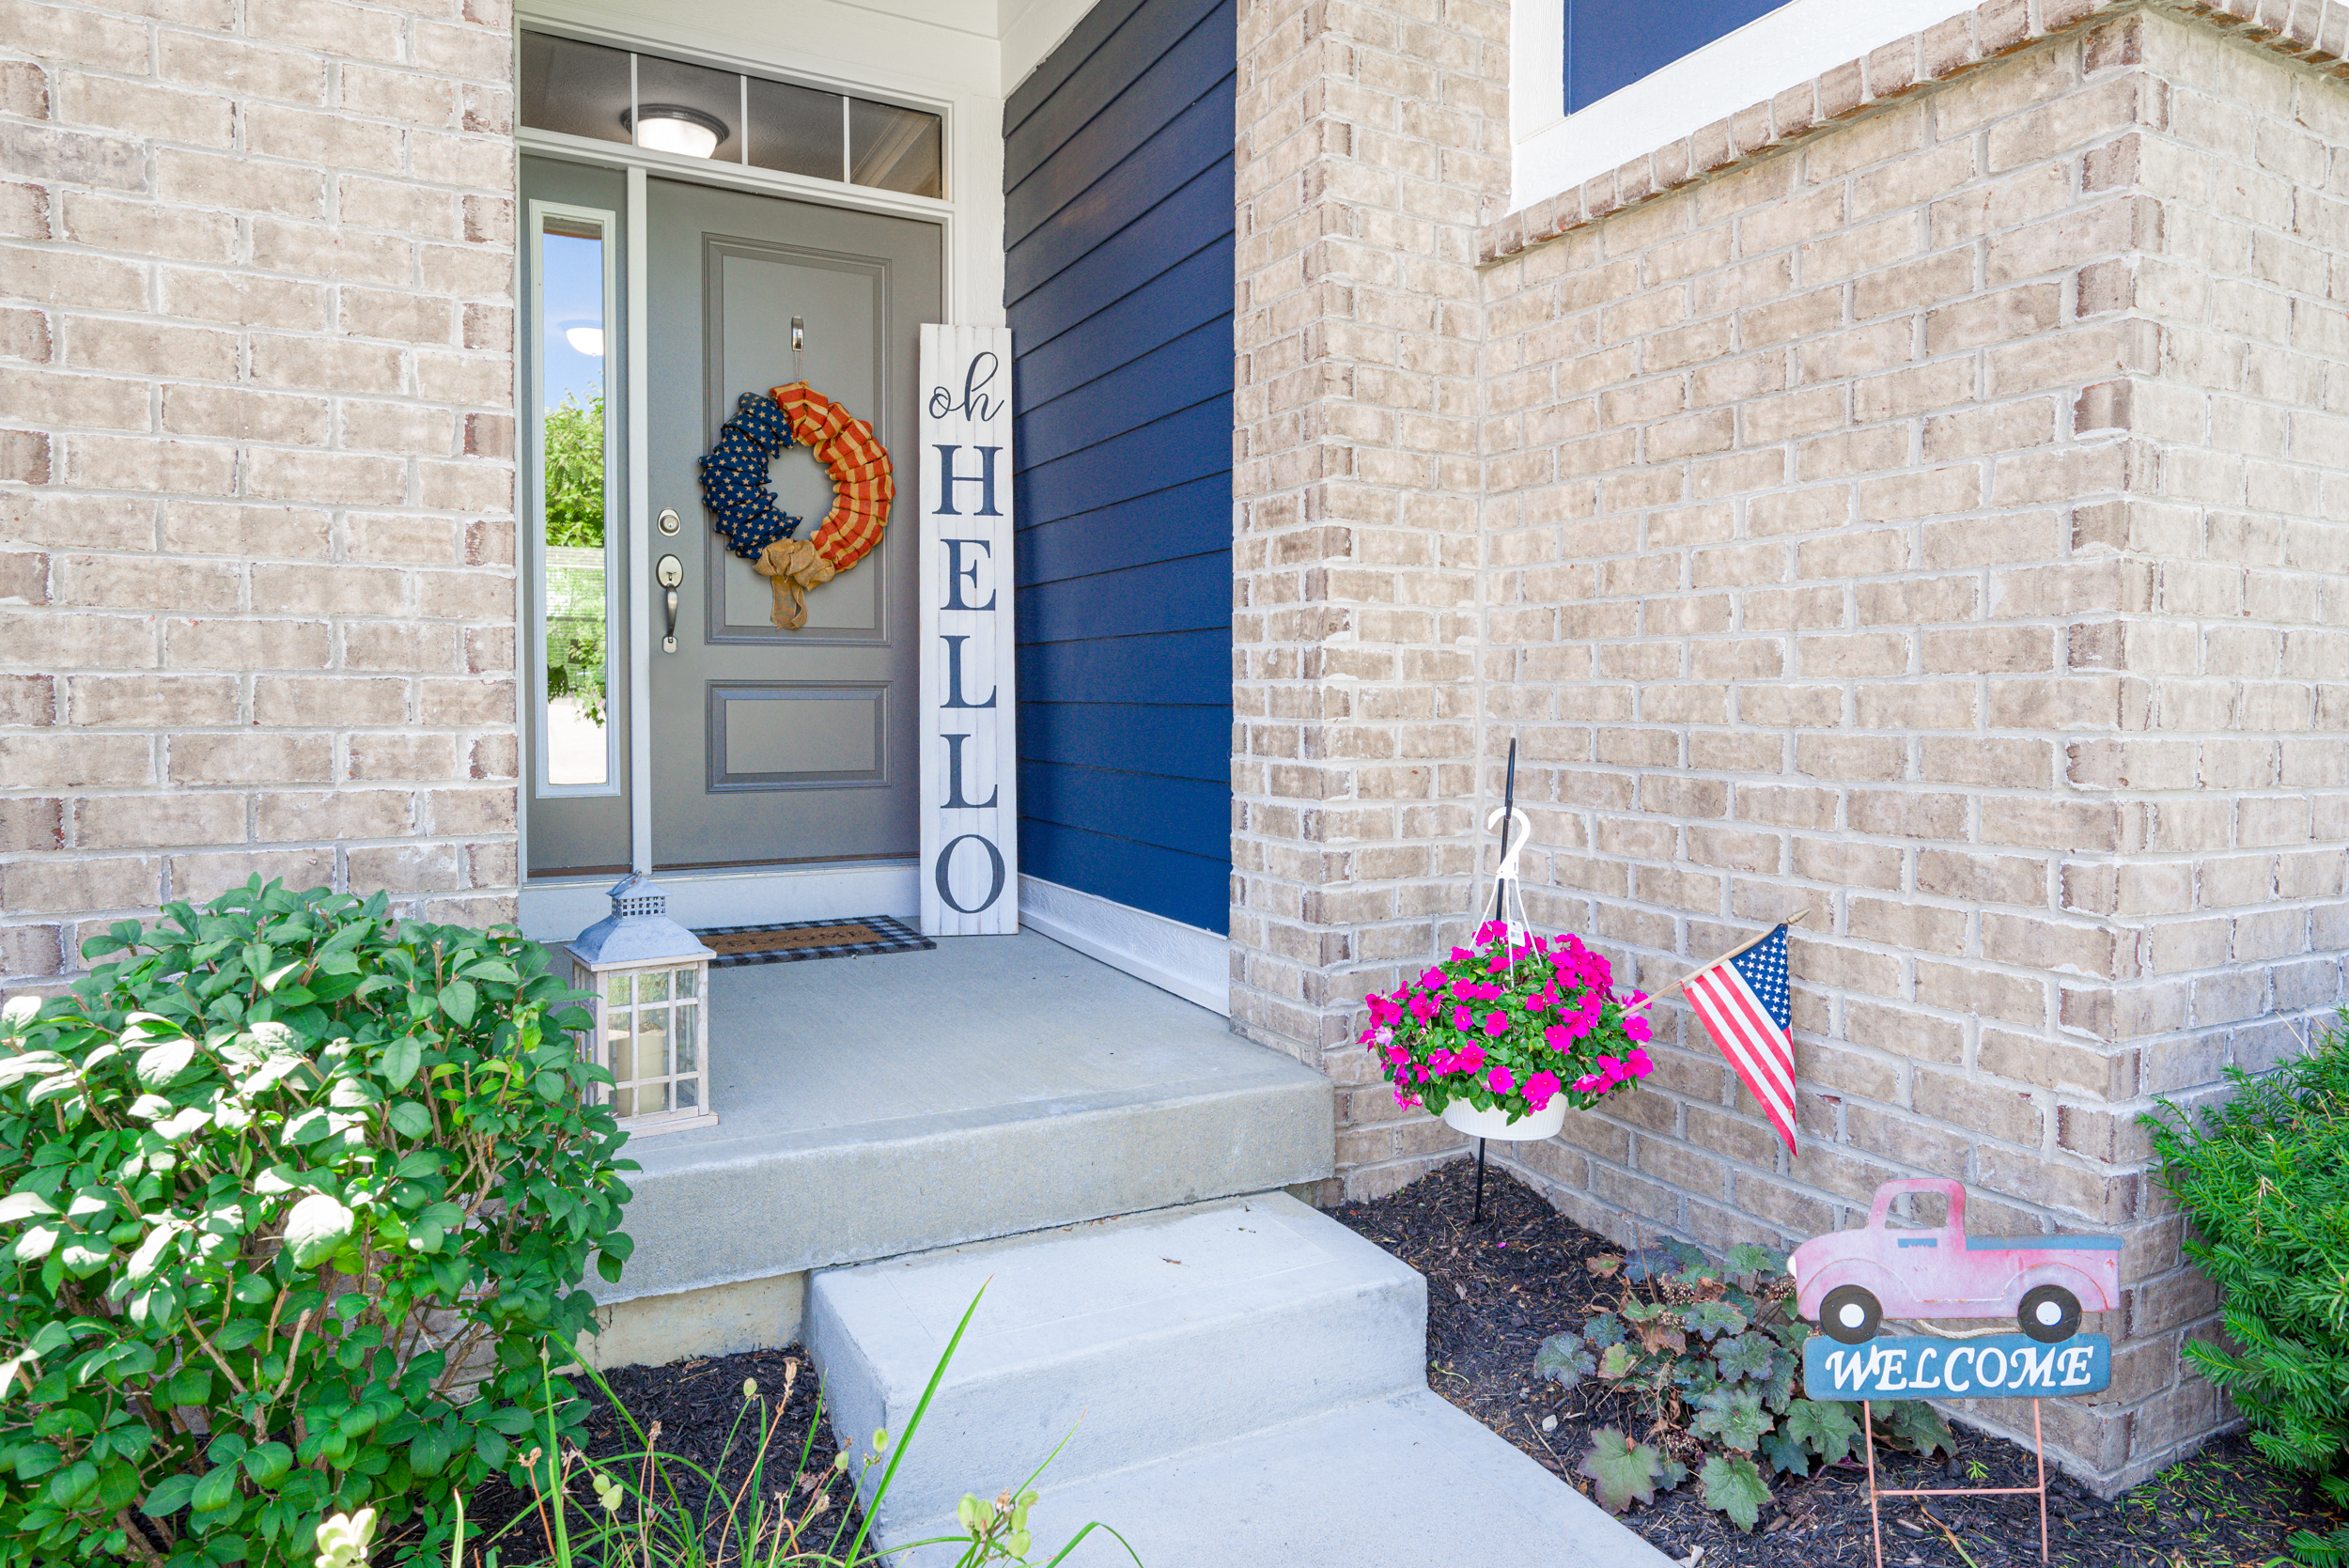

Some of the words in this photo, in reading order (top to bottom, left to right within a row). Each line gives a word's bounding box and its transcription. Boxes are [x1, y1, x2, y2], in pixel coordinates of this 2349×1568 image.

[928, 351, 1004, 422] oh
[932, 444, 1005, 914] HELLO
[1825, 1343, 2094, 1392] WELCOME
